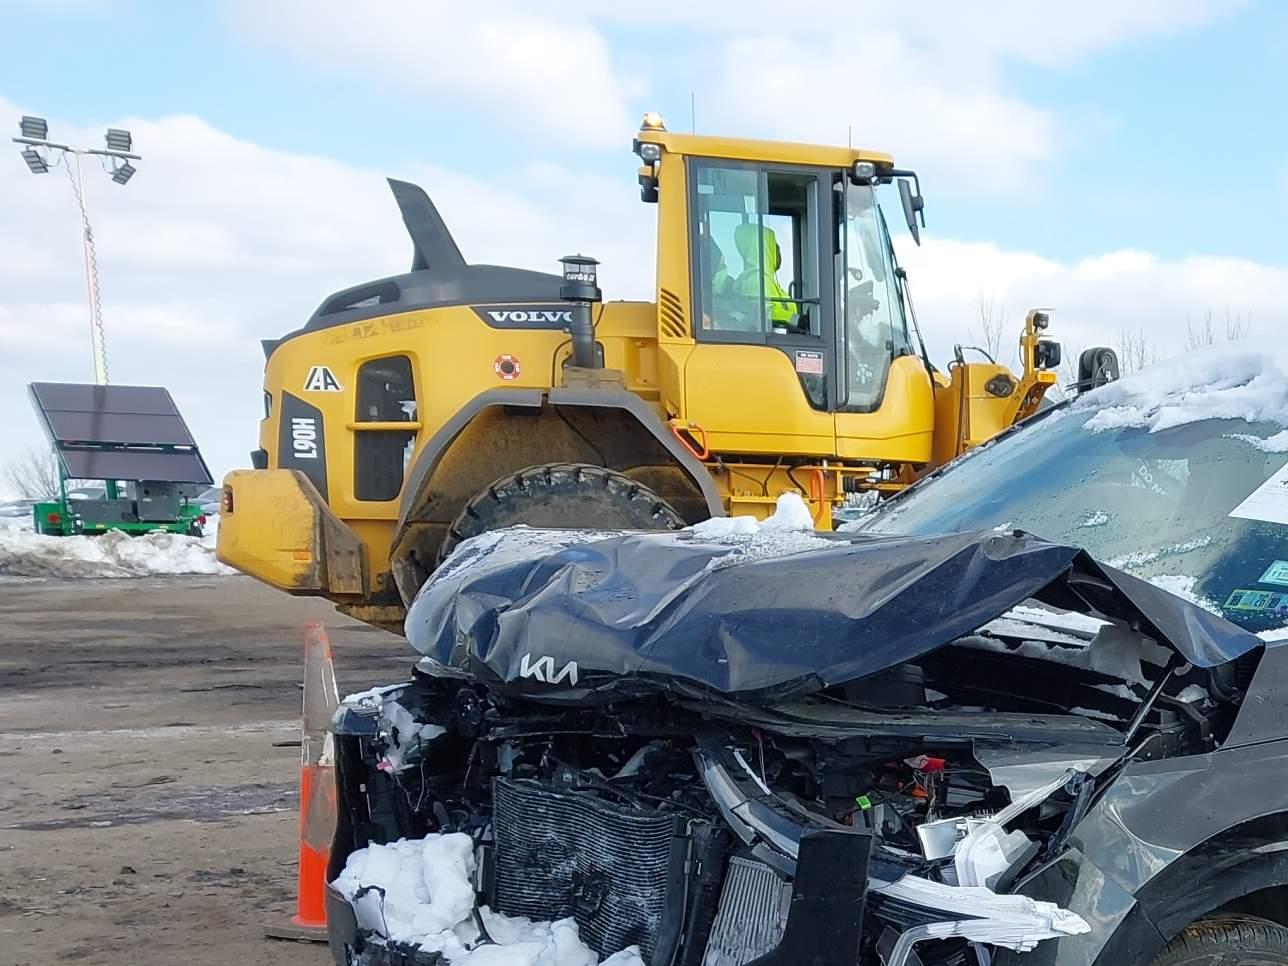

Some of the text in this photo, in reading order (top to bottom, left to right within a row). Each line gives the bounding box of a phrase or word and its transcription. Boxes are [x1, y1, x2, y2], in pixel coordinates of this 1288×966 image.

[292, 418, 318, 458] L90H
[1254, 594, 1269, 608] 26
[520, 652, 578, 687] KIA
